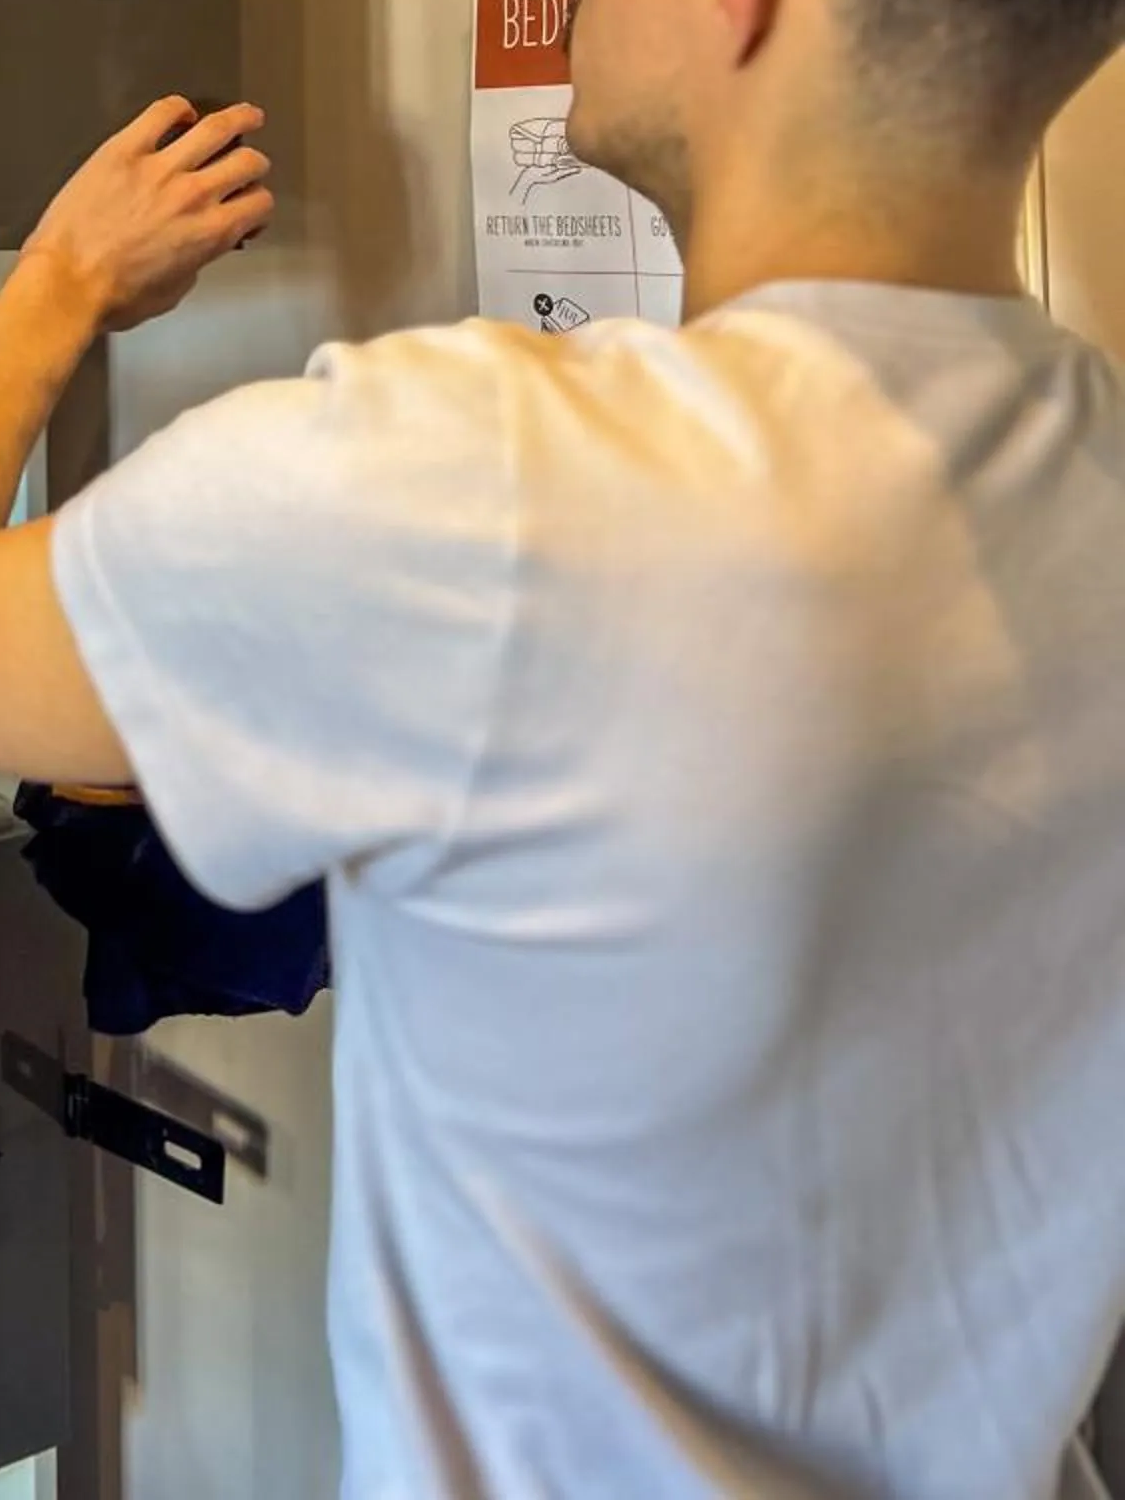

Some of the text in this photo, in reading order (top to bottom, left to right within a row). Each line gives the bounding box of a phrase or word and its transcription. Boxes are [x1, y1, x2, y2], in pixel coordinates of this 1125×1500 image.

[486, 214, 623, 238] RETURN THE BEDSHEETS
